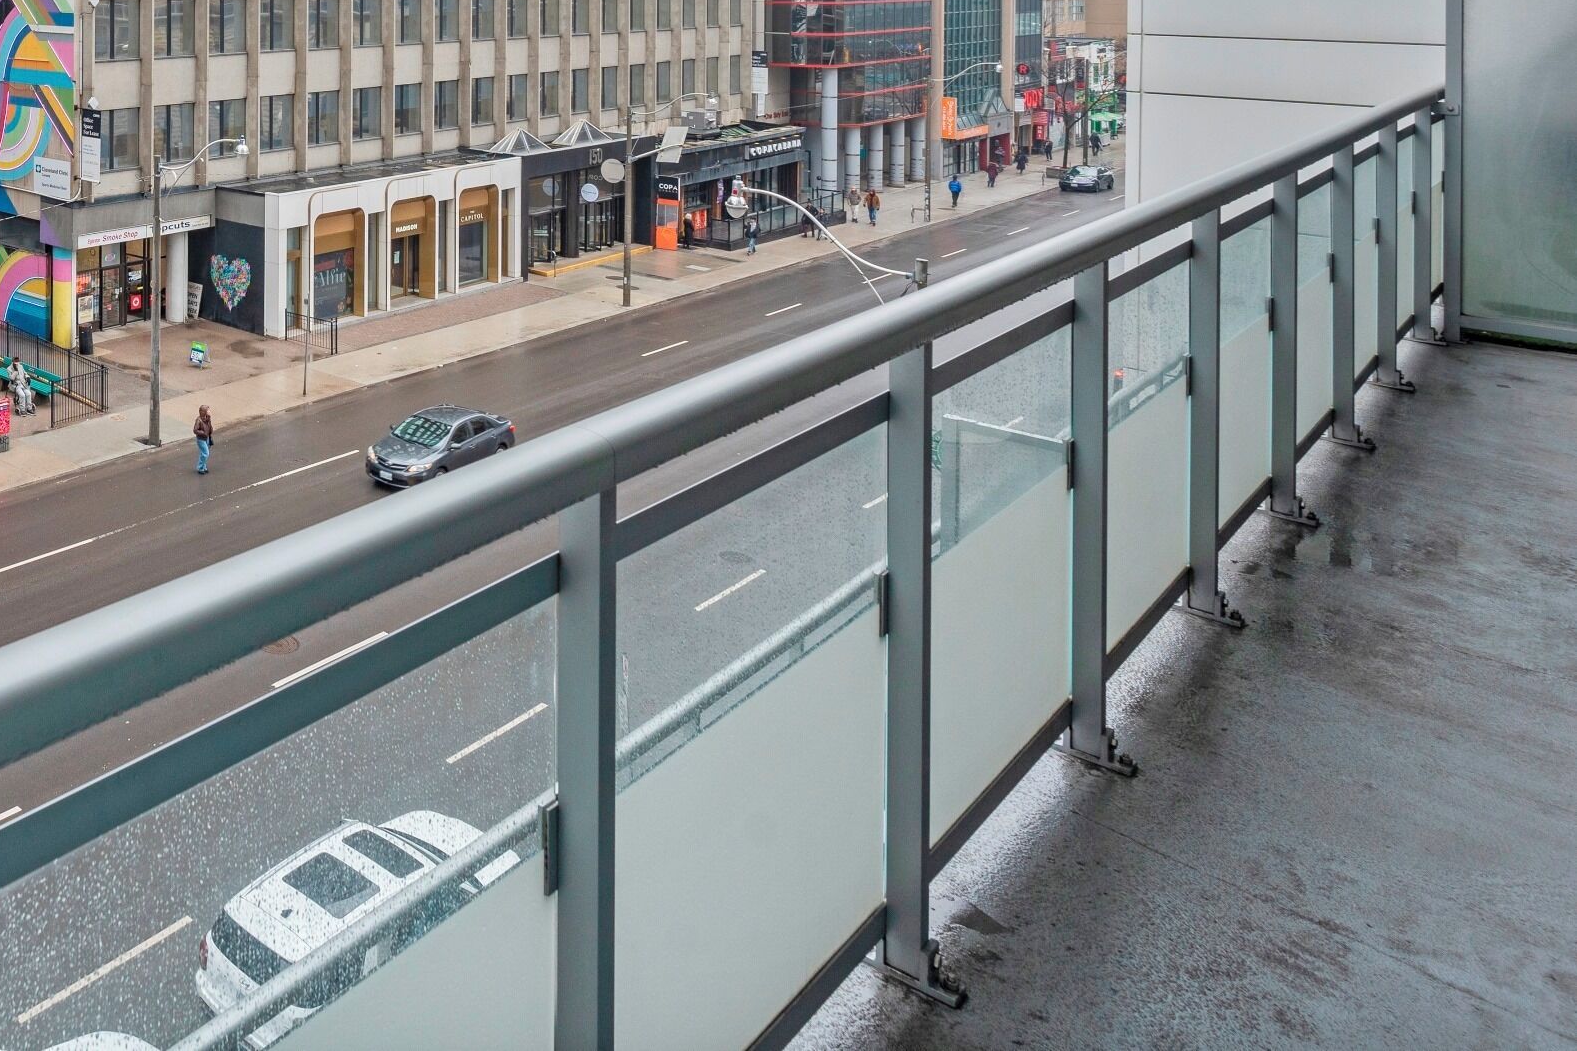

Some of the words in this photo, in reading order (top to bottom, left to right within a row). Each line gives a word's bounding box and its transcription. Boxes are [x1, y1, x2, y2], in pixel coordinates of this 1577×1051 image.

[1018, 63, 1028, 74] R
[750, 139, 802, 156] COPACABANA
[589, 148, 603, 165] 150
[658, 183, 678, 191] COPA
[460, 212, 484, 223] CAPITOL
[149, 221, 191, 234] Tpcuts
[395, 223, 418, 234] MADISON
[102, 233, 123, 242] Smoke
[123, 230, 139, 239] Shop
